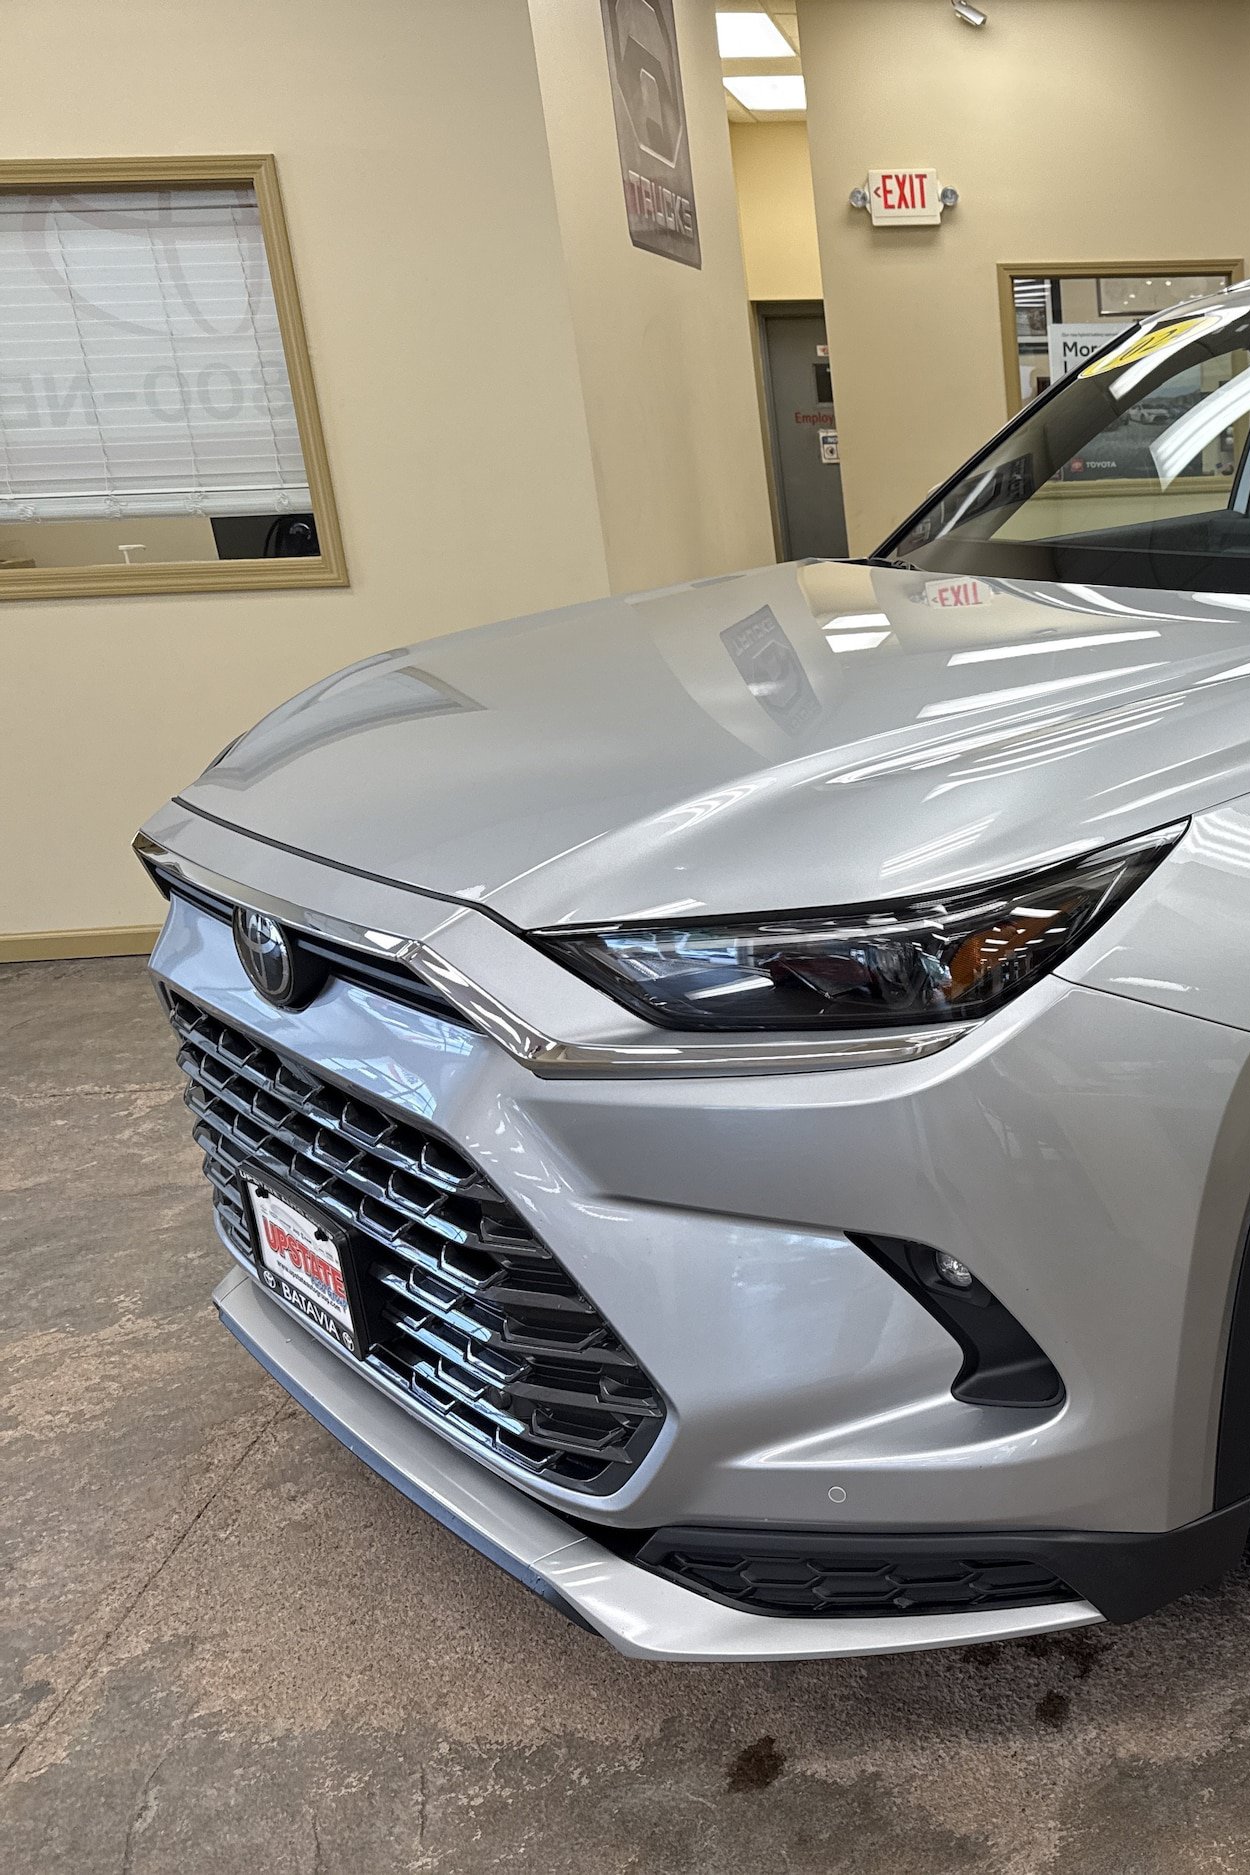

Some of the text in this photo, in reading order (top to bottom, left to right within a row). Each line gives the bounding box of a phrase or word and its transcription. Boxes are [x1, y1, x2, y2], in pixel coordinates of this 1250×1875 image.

[628, 169, 695, 239] TRUCKS
[881, 173, 928, 210] EXIT
[1063, 341, 1100, 357] Mor
[263, 1216, 347, 1299] UPSTATE
[281, 1282, 341, 1341] BATAVIA
